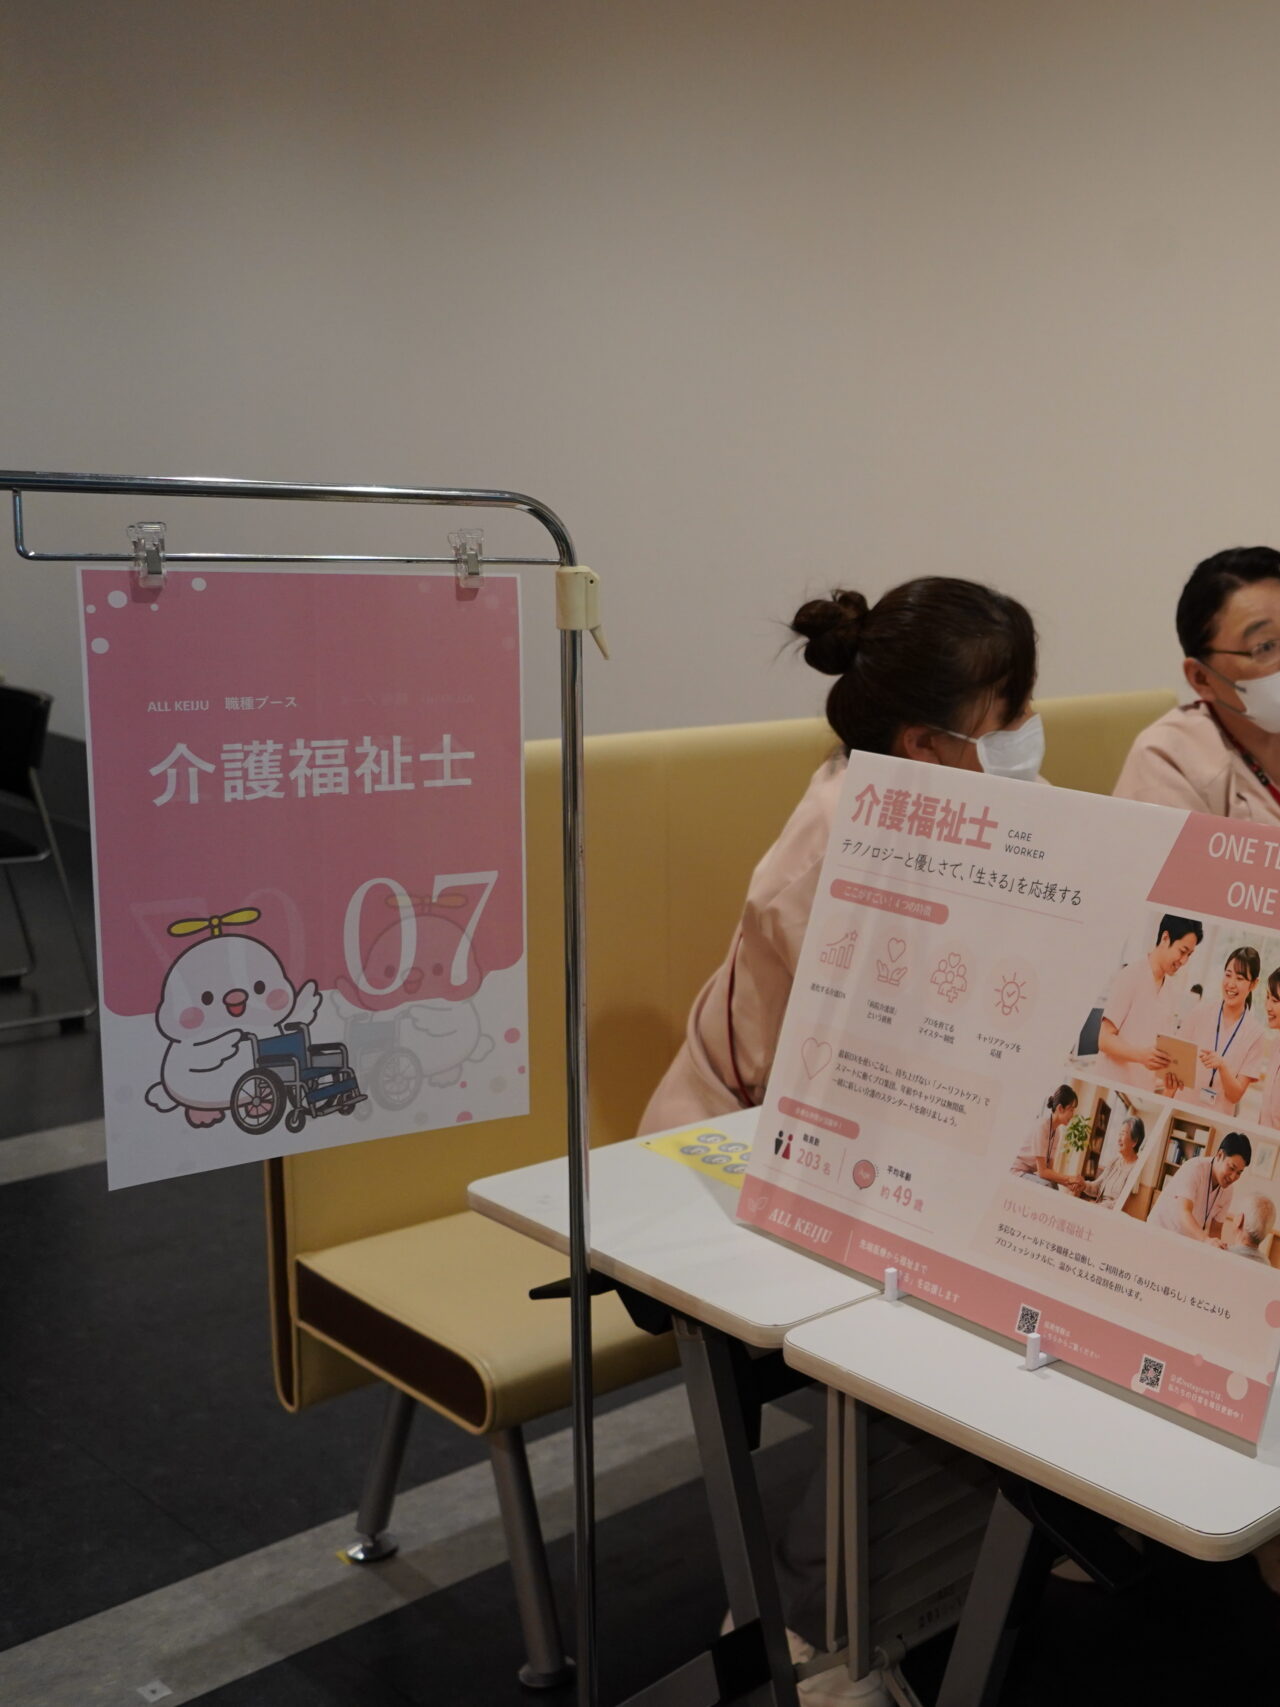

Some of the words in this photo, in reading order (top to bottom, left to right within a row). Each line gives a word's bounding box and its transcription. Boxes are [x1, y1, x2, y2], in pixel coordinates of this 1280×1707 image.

[148, 701, 171, 712] ALL
[175, 700, 209, 712] KEIJU
[225, 696, 297, 711] 職種ブース
[149, 733, 475, 807] 介護福祉士
[851, 783, 999, 850] 介護福祉士
[1005, 844, 1045, 861] WORKER
[1008, 829, 1033, 842] CARE
[1208, 832, 1258, 865] ONE
[1227, 881, 1278, 915] ONE
[344, 870, 499, 998] 07
[768, 1208, 793, 1228] ALL
[793, 1217, 833, 1244] KEIJU
